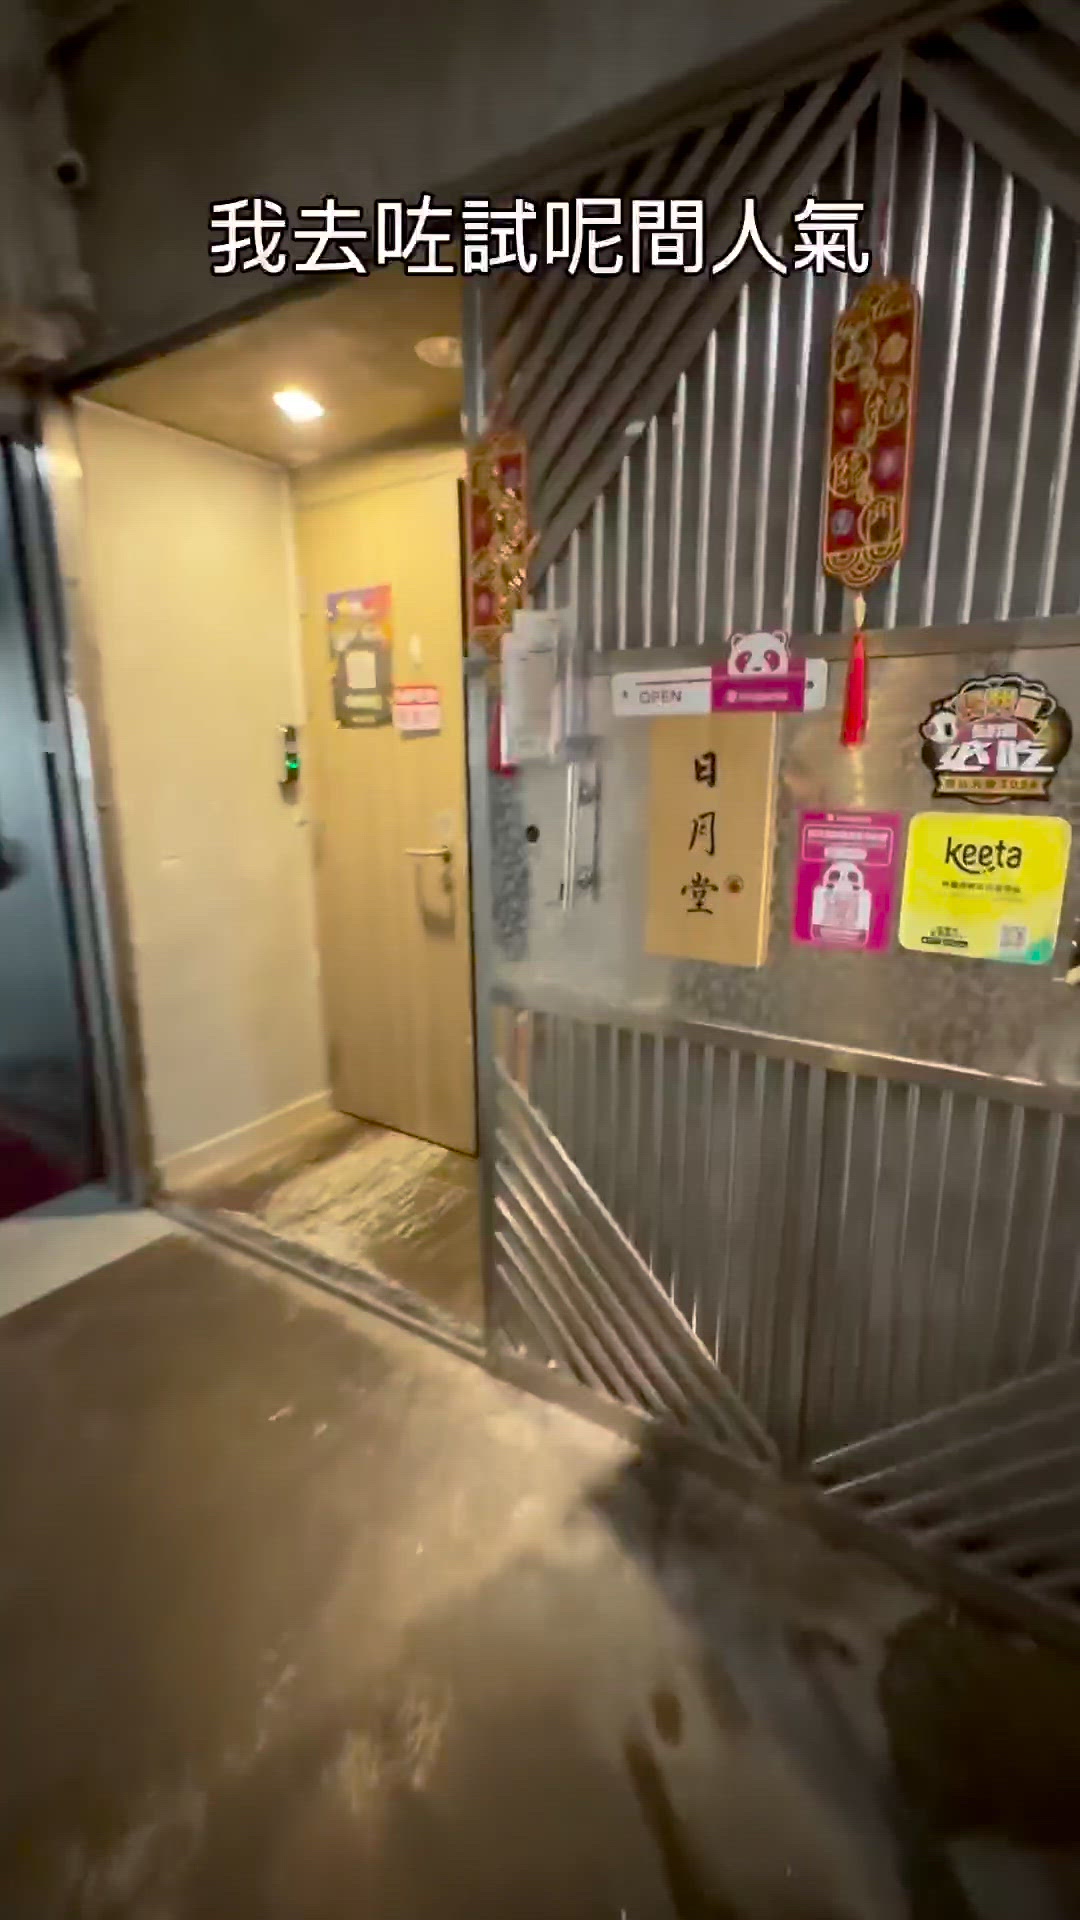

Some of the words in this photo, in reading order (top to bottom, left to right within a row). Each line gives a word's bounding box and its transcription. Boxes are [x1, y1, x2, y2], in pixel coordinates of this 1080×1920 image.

[639, 690, 683, 704] OPEN
[680, 751, 719, 915] 日月堂
[944, 836, 1023, 875] keeta
